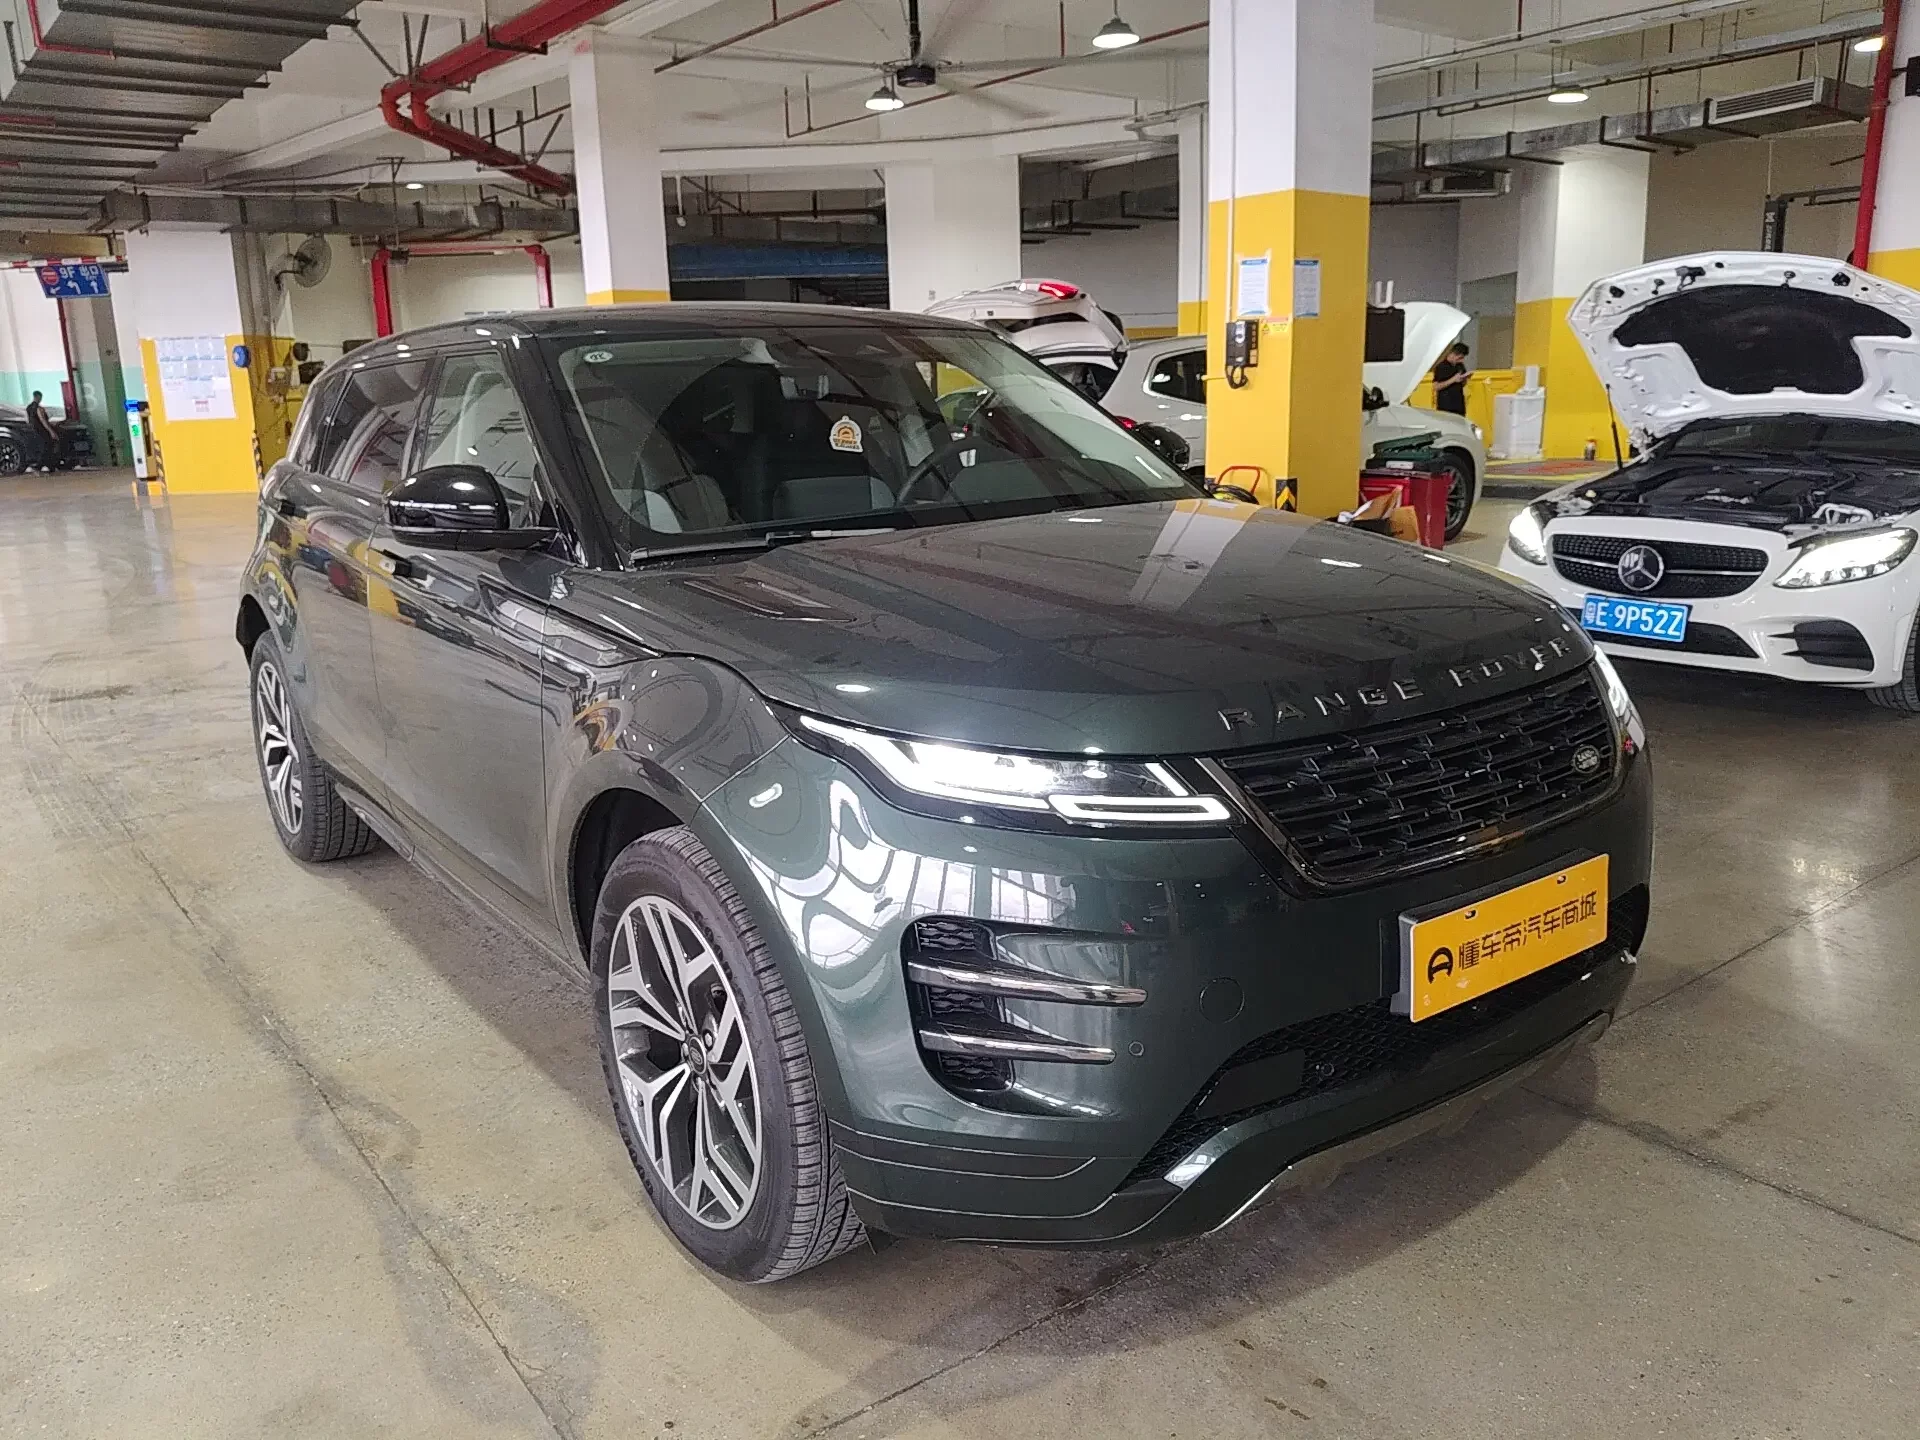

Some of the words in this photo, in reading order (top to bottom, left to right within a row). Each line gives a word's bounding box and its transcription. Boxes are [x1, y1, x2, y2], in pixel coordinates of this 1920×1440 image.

[1217, 678, 1425, 731] RANGE
[1458, 890, 1597, 970] 懂车帝汽车商城
